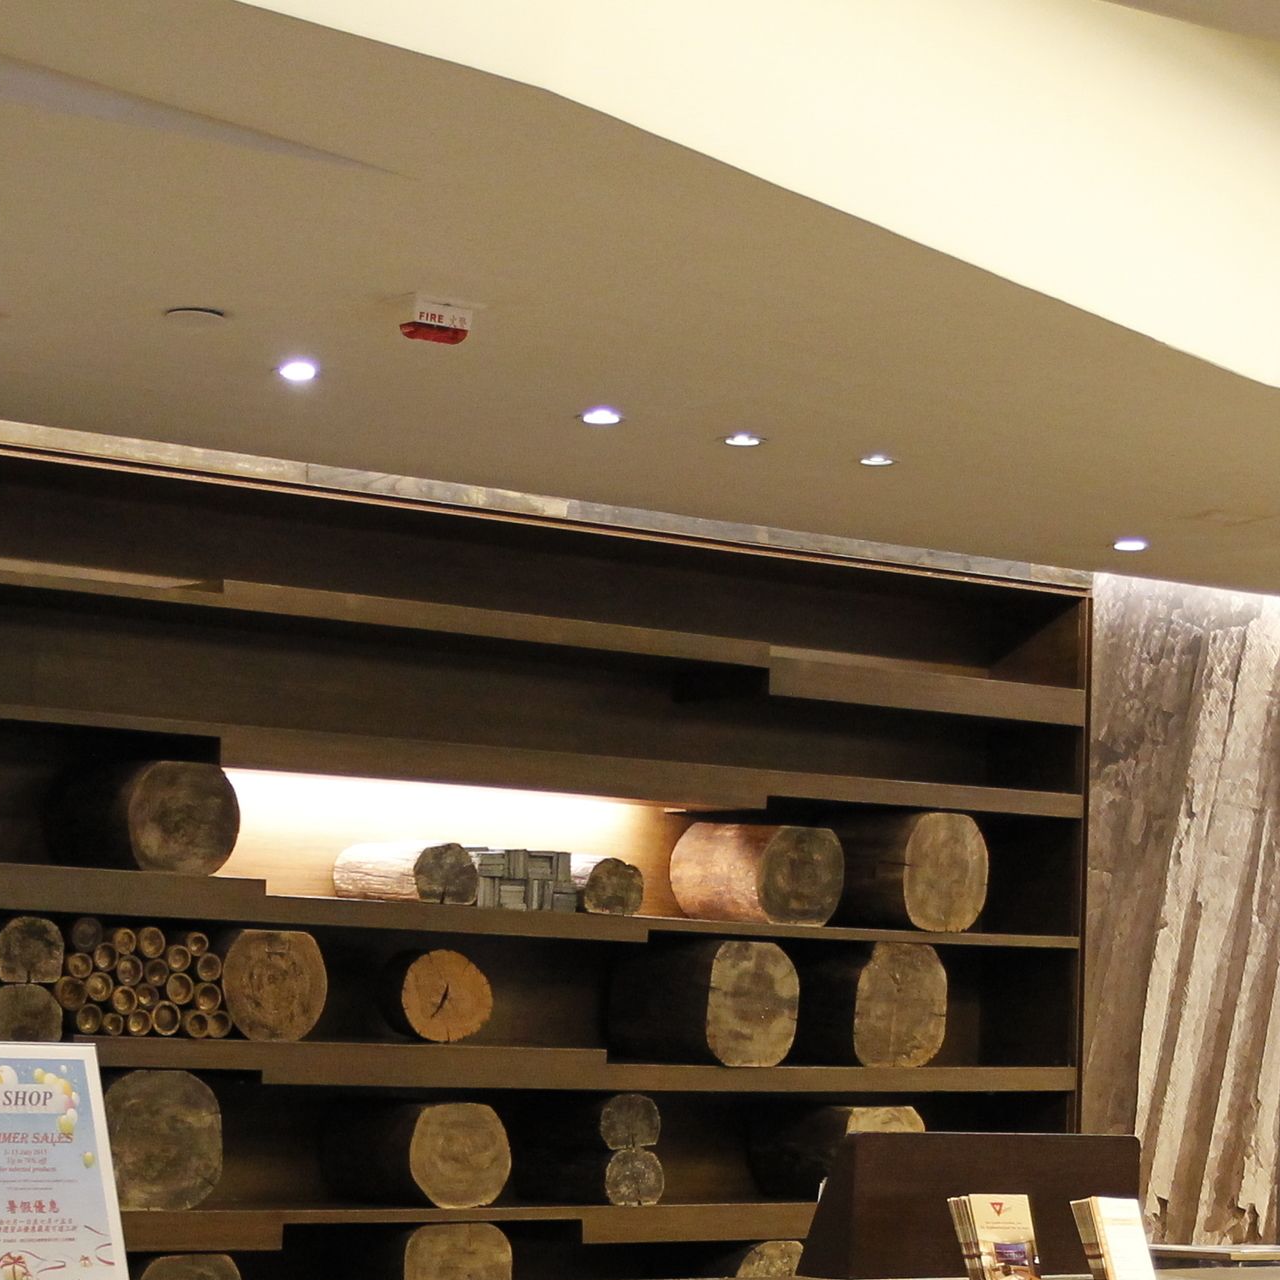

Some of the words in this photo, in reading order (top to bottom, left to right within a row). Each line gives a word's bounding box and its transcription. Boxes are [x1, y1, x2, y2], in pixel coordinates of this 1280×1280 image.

[418, 311, 445, 324] FIRE
[2, 1090, 53, 1106] SHOP
[31, 1132, 74, 1145] SALES
[6, 1199, 60, 1214] 暑假優惠
